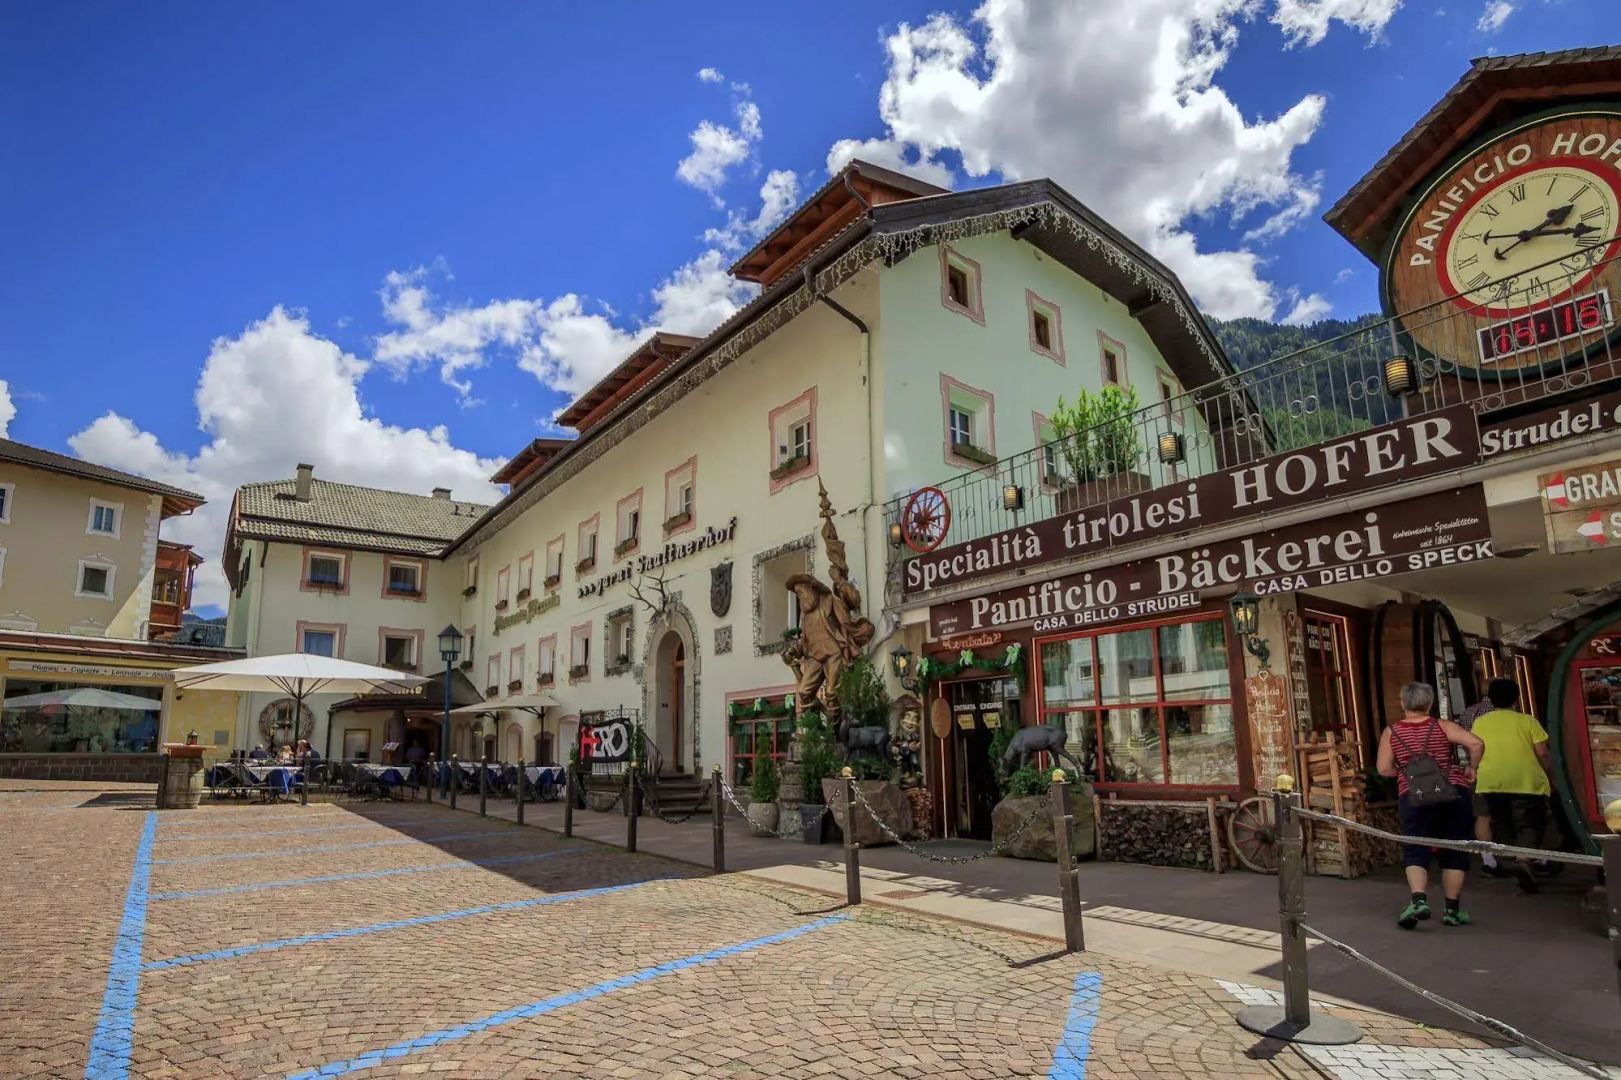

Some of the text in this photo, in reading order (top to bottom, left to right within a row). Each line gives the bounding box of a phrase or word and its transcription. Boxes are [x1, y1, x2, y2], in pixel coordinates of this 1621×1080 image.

[1410, 132, 1621, 266] PANIFICIO HOF
[907, 417, 1462, 591] Specialità tirolesi HOFER
[1420, 535, 1453, 548] seit 1864
[1434, 517, 1479, 533] Spezialitäten
[970, 573, 1117, 629] Panificio
[1156, 512, 1385, 595] Bäckerei
[1254, 540, 1493, 596] CASA DELLO SPECK
[1033, 593, 1200, 632] CASA DELLO STRUDEL
[70, 666, 100, 674] Coperte
[111, 669, 141, 677] Lenzuola
[954, 702, 1003, 712] ENTRATA EINGANG
[580, 723, 629, 760] HERO
